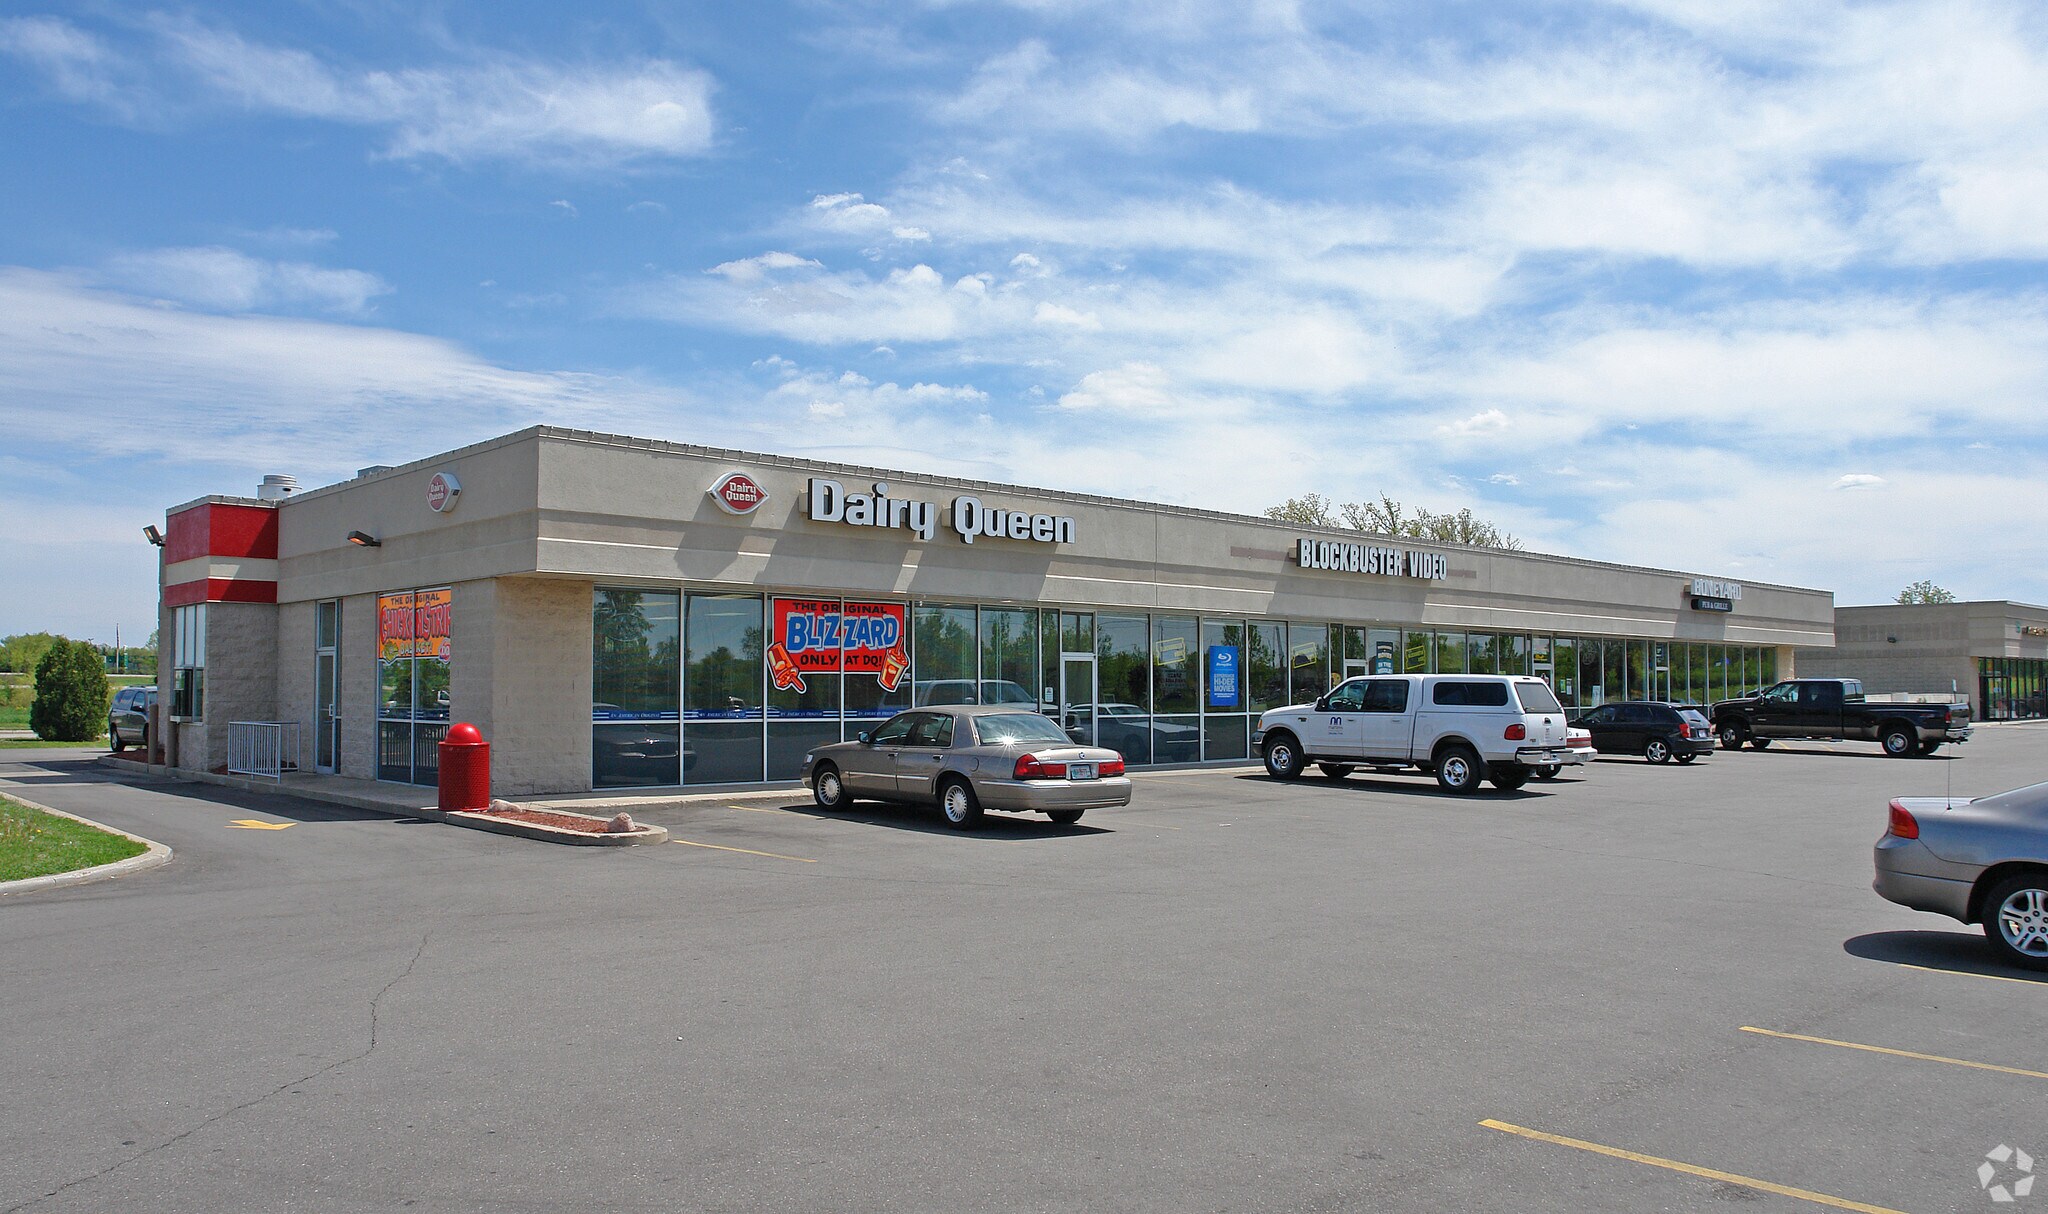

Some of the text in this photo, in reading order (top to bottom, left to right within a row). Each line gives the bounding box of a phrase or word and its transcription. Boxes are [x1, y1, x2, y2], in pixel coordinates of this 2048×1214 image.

[729, 482, 756, 495] Dairy
[726, 490, 757, 502] Queen
[808, 478, 1075, 544] Dairy Queen
[1297, 539, 1448, 581] BLOCKBUSTER VIDEO
[1691, 579, 1741, 600] BONEYARD
[391, 597, 403, 606] THE
[792, 602, 888, 614] THE ORIGINAL
[786, 612, 900, 653] BLIZZARD
[800, 654, 883, 667] ONLY AT DQ!
[1213, 685, 1235, 693] MOVIES
